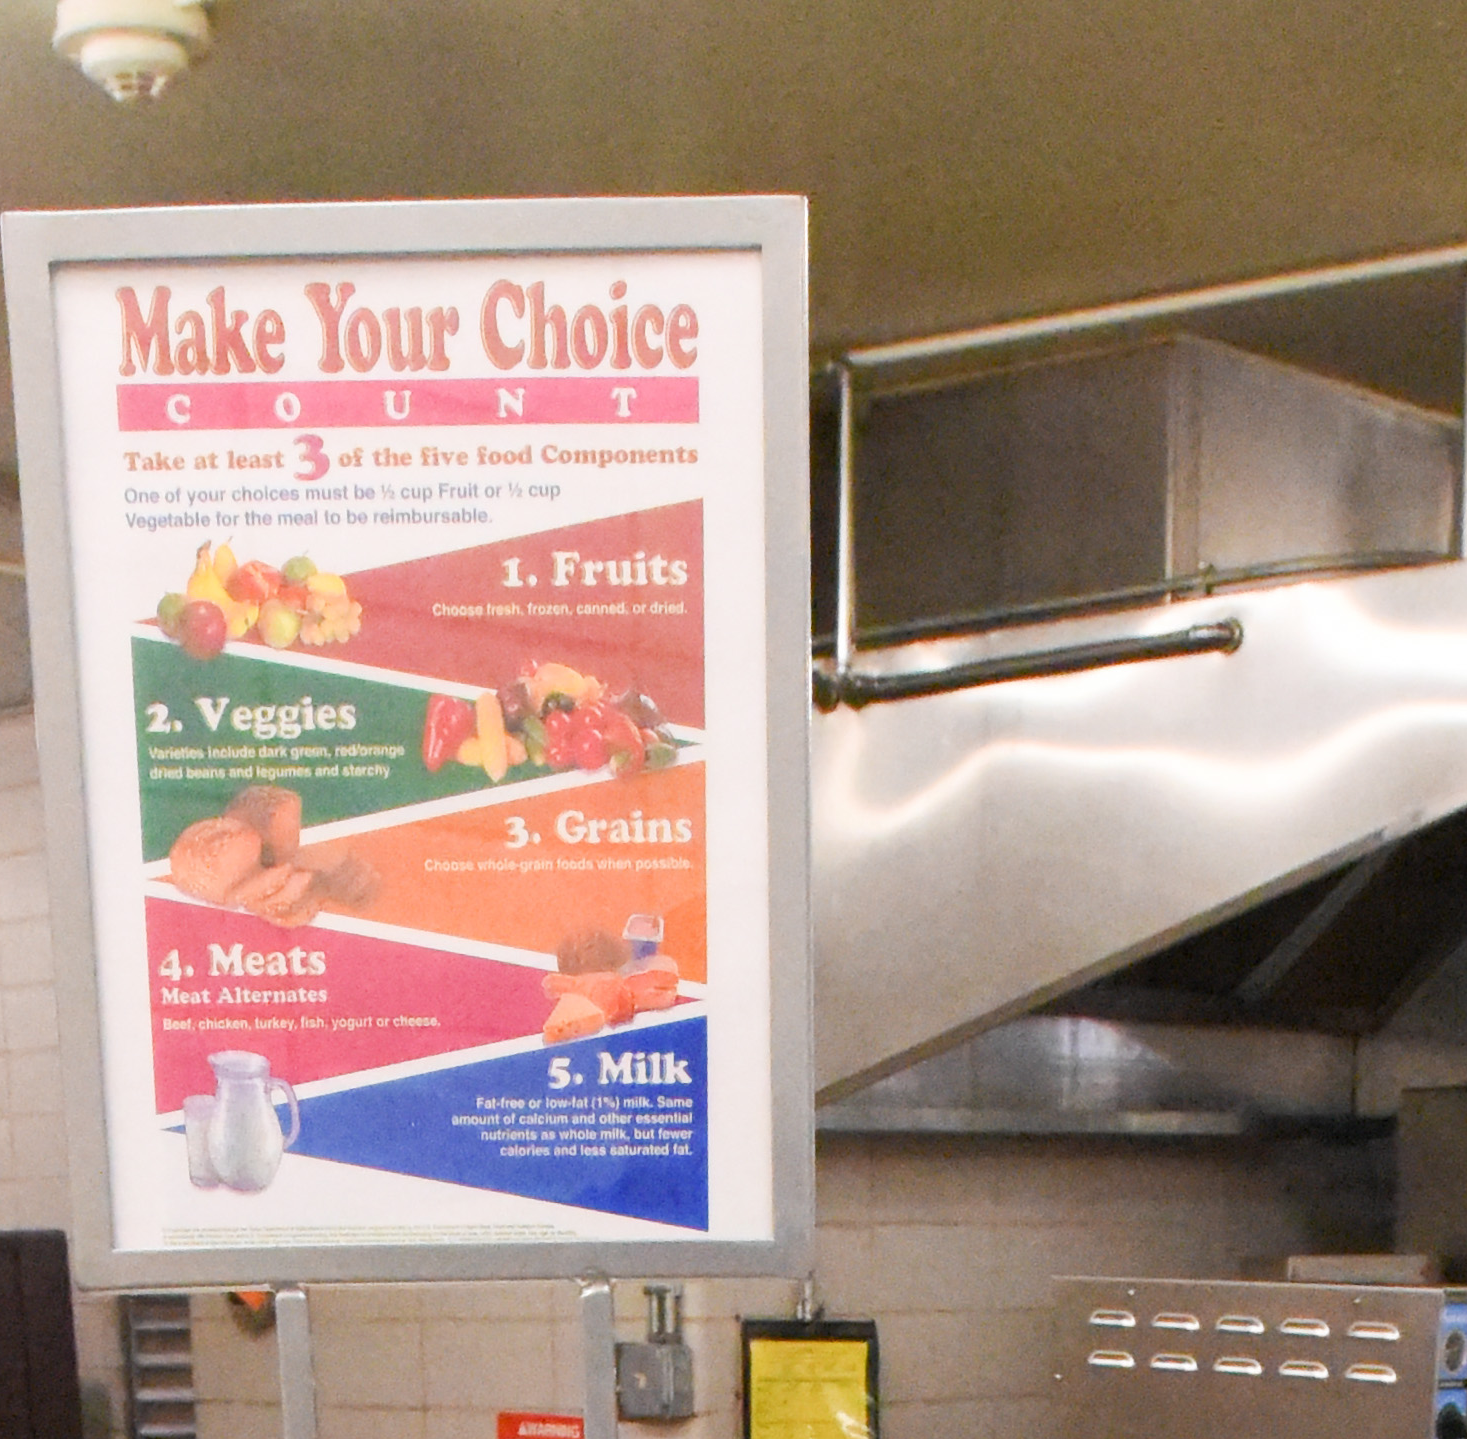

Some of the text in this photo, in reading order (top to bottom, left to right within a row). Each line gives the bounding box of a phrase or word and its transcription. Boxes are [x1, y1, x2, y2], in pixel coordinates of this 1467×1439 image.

[117, 279, 699, 376] Make Your Choice
[124, 434, 698, 481] Take at least 3 of the five food Components
[124, 487, 160, 503] One
[165, 487, 182, 502] of
[187, 490, 226, 506] your
[232, 486, 299, 502] choices
[305, 486, 348, 501] must
[353, 485, 375, 500] be
[400, 486, 432, 502] cup
[438, 483, 478, 499] Fruit
[484, 486, 502, 498] or
[528, 484, 561, 501] cup
[125, 507, 493, 532] Vegetable for the meal to be reimbursable.
[501, 550, 688, 588] 1. Fruits
[432, 601, 687, 617] Choose fresh, frozen, canned, or dried.
[145, 695, 357, 740] 2. Veggies
[149, 746, 204, 760] Varieties
[207, 745, 255, 759] include
[258, 744, 286, 758] dark
[335, 743, 405, 760] red/orange
[149, 763, 390, 782] dried beans and legumes and starchy
[503, 809, 692, 849] 3. Grains
[424, 857, 692, 873] Choose whole-grain foods when possible.
[158, 943, 327, 981] 4. Meats
[161, 986, 328, 1005] Meat Alternates
[162, 1014, 441, 1032] Beef, chicken, turkey, fish, yogurt or cheese.
[547, 1051, 693, 1089] 5. Milk
[476, 1095, 693, 1110] Fat-free or low-fat (1%) milk. Same
[451, 1112, 693, 1126] amount of calcium and other essential
[480, 1127, 693, 1142] nutrients as whole milk, but fewer
[499, 1144, 693, 1157] calories and less saturated fat.
[526, 1422, 580, 1439] WARNING
